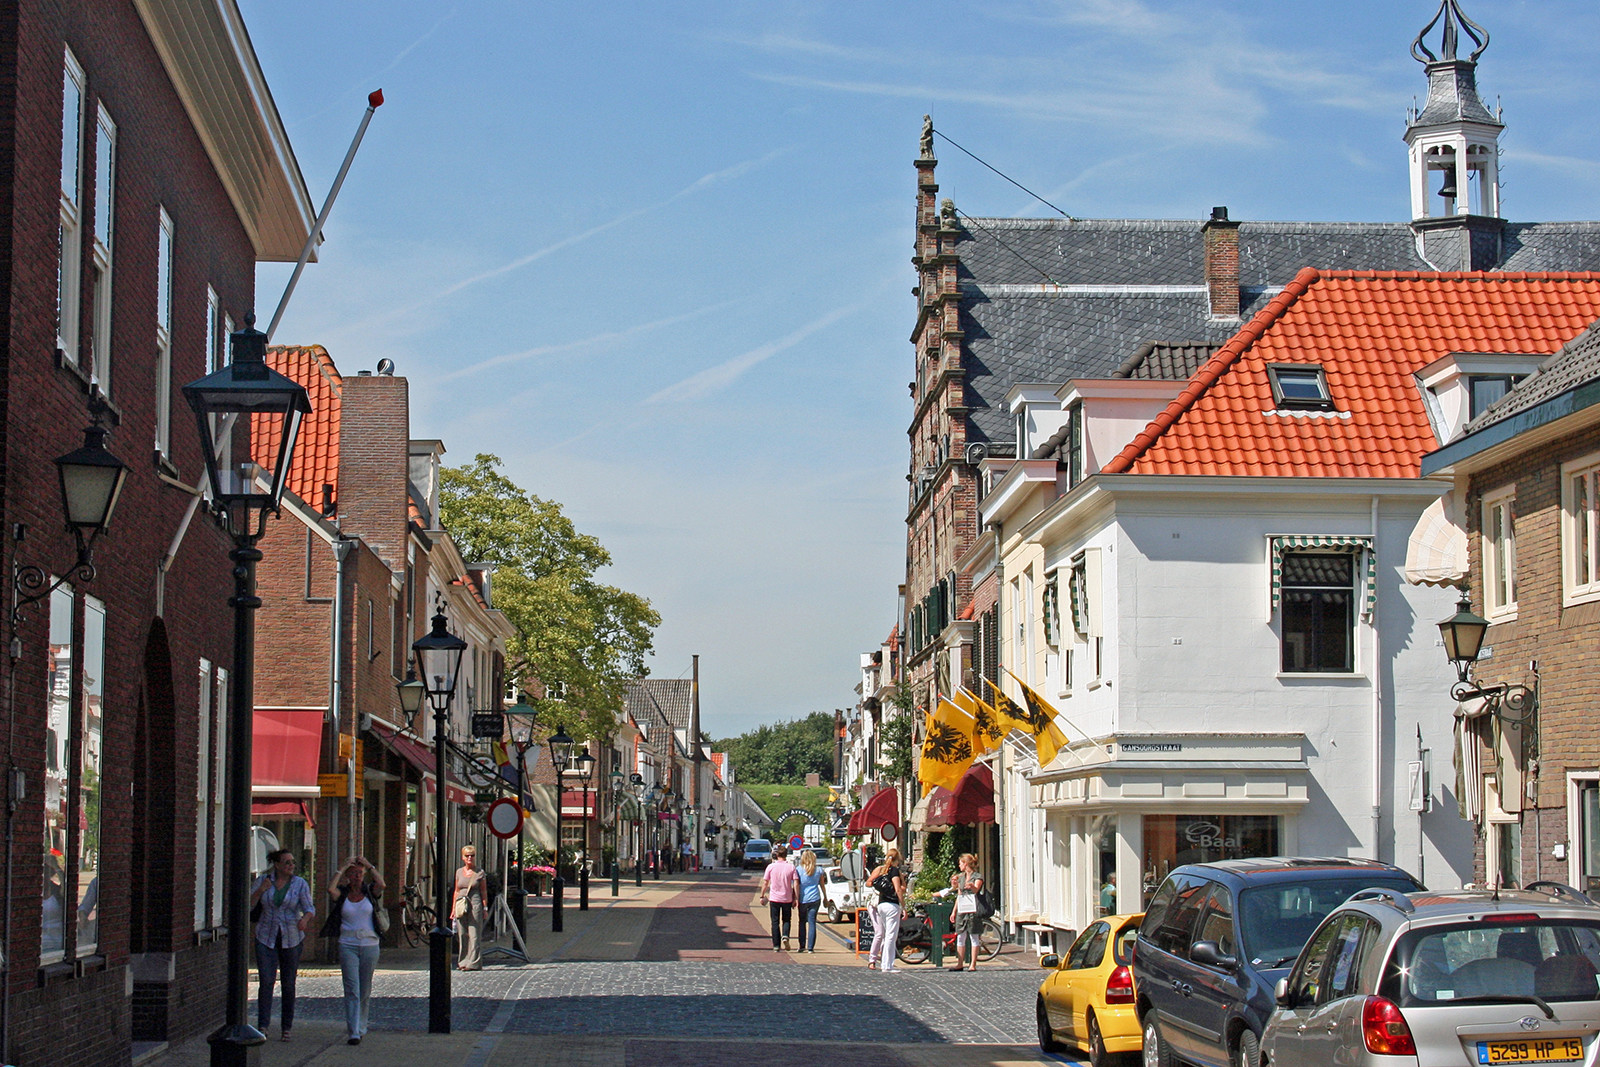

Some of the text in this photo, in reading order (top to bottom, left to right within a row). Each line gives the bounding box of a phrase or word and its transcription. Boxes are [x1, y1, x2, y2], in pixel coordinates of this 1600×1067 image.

[777, 813, 788, 823] Het
[1200, 834, 1241, 848] Baal
[1491, 1041, 1580, 1060] 5299 HP 15
